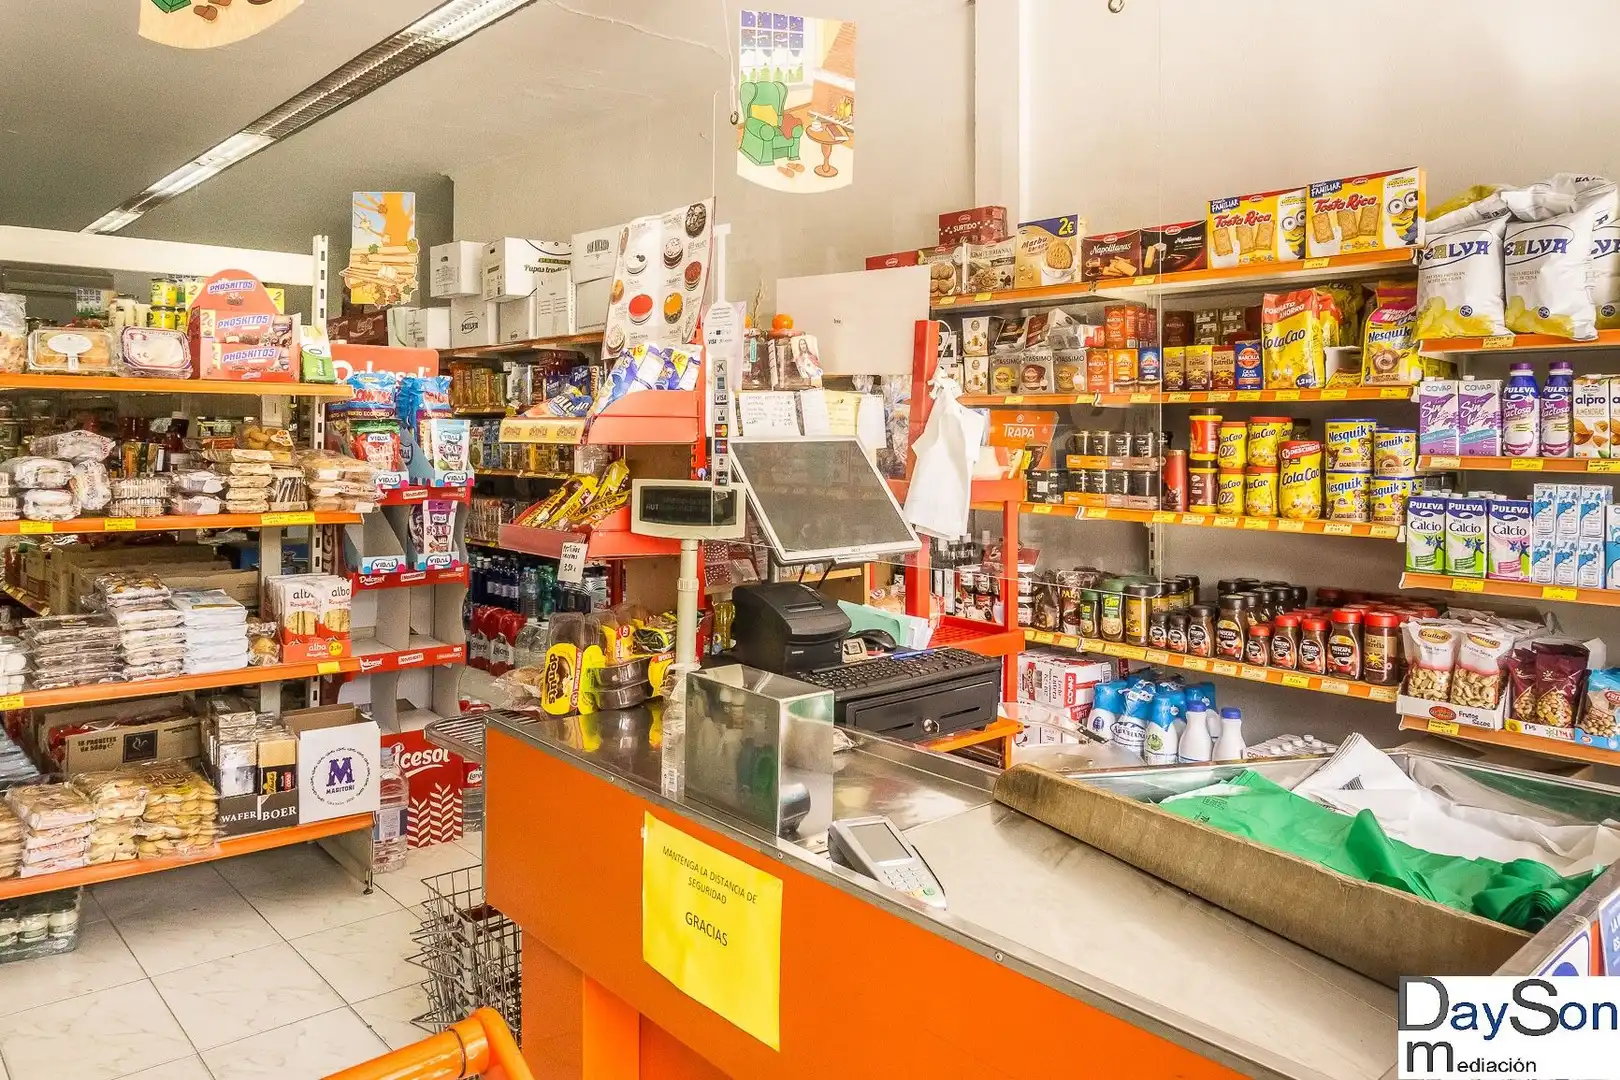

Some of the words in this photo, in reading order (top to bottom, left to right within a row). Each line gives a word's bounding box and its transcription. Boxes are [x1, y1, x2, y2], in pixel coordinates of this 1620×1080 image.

[1311, 182, 1341, 197] FAMILIAR
[1313, 197, 1346, 213] Tosta
[1346, 193, 1377, 210] Rica
[1214, 213, 1244, 228] Tosta
[1244, 210, 1272, 226] Rica
[953, 222, 977, 232] SURTIDO
[1058, 217, 1075, 236] 2€
[1090, 242, 1132, 256] Napolitanas
[524, 264, 545, 274] Tapas
[1264, 302, 1296, 314] FORMATO
[1279, 304, 1305, 318] AHORRO
[218, 314, 270, 329] PHOSKITOS
[1368, 326, 1412, 344] Nesquik
[223, 348, 275, 362] PHOSKITOS
[1464, 384, 1492, 392] COVAP
[1506, 401, 1516, 410] Sin
[1544, 400, 1555, 410] Sin
[1575, 394, 1606, 407] alpro
[1504, 406, 1532, 418] lactosa
[1542, 406, 1570, 418] lactosa
[1002, 423, 1035, 439] TRAPA
[1328, 425, 1366, 442] Nesquik
[1375, 436, 1404, 449] esquik
[1220, 445, 1236, 458] 0%
[1282, 468, 1320, 486] ColaCao
[1370, 482, 1400, 497] esquik
[1220, 492, 1235, 503] 0%
[1408, 501, 1444, 510] PULEVA
[1448, 502, 1484, 512] PULEVA
[1492, 504, 1529, 514] PULEVA
[1410, 520, 1442, 532] Calcio
[1448, 522, 1482, 534] Calcio
[1492, 524, 1527, 536] Calcio
[375, 561, 396, 569] VIDAL
[547, 652, 560, 705] donuts
[1458, 710, 1479, 720] Frutos
[220, 810, 256, 822] WAFER
[262, 806, 297, 821] BOER
[662, 846, 700, 873] MANTENGA
[700, 866, 708, 877] LA
[710, 871, 745, 898] DISTANCIA
[746, 891, 758, 904] DE
[688, 876, 727, 904] SEGURIDAD
[684, 911, 728, 947] GRACIAS
